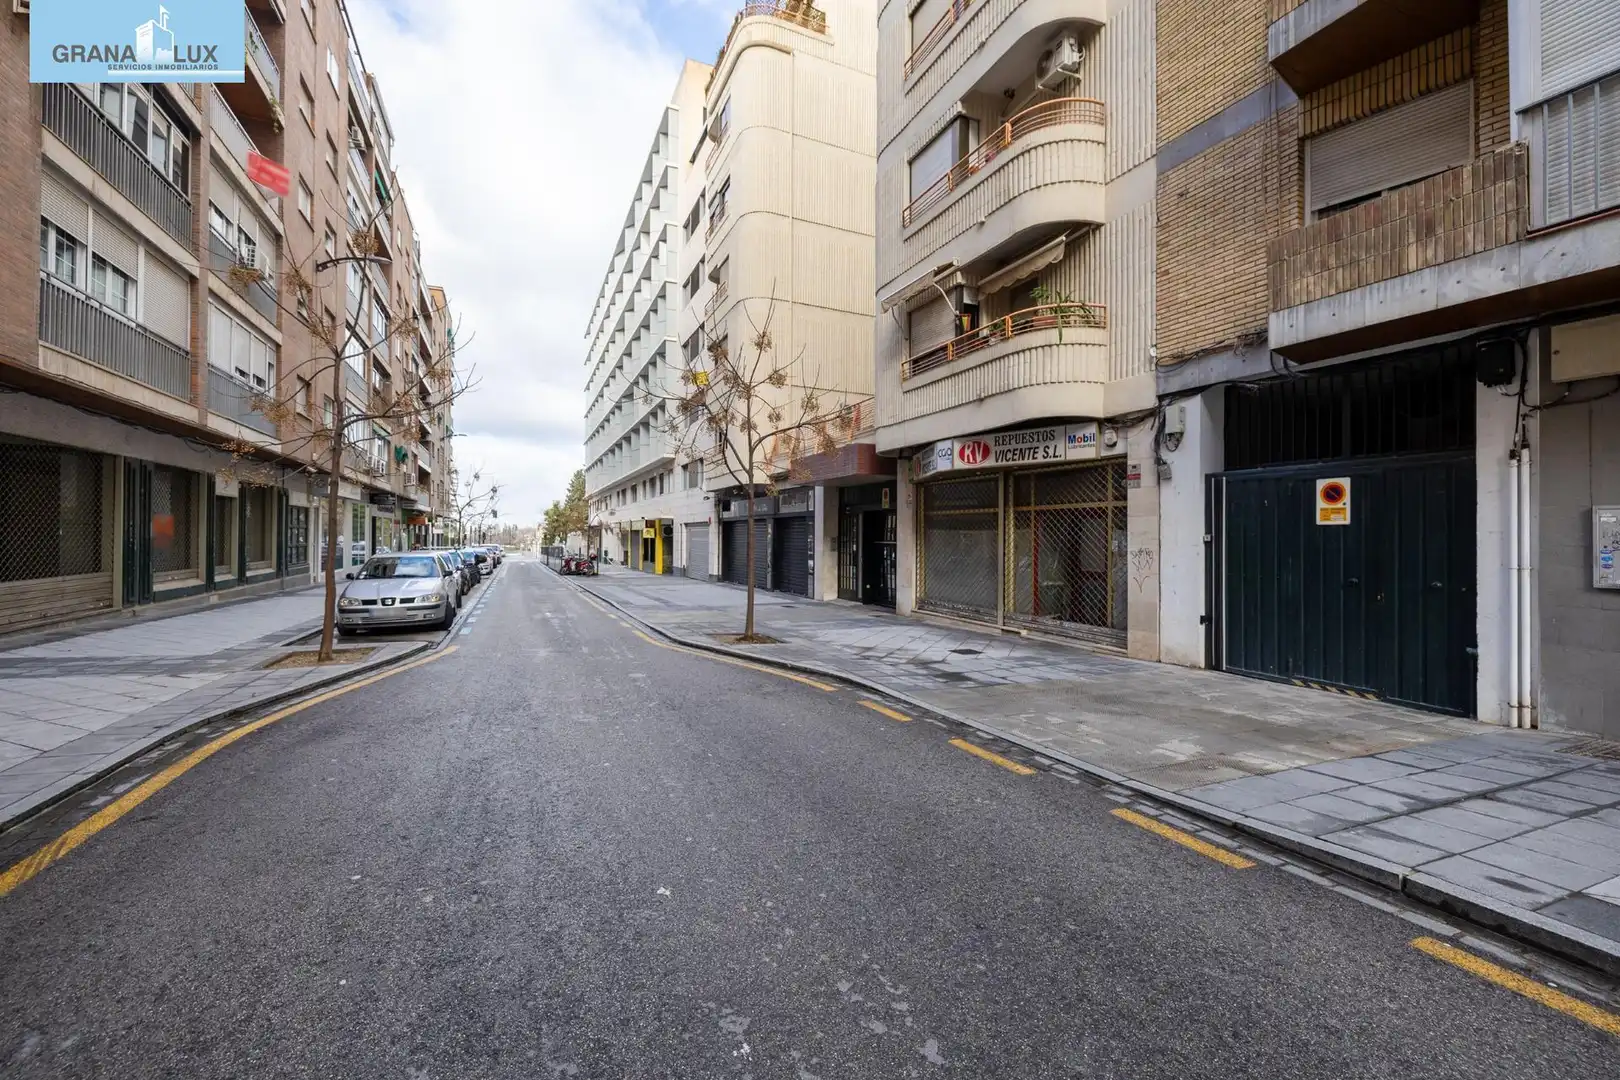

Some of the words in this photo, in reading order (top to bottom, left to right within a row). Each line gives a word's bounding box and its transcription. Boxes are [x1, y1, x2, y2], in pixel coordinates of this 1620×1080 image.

[994, 429, 1056, 447] REPUESTOS
[1067, 432, 1096, 445] Mobil
[994, 446, 1040, 463] VICENTE
[1042, 444, 1062, 459] S.L.
